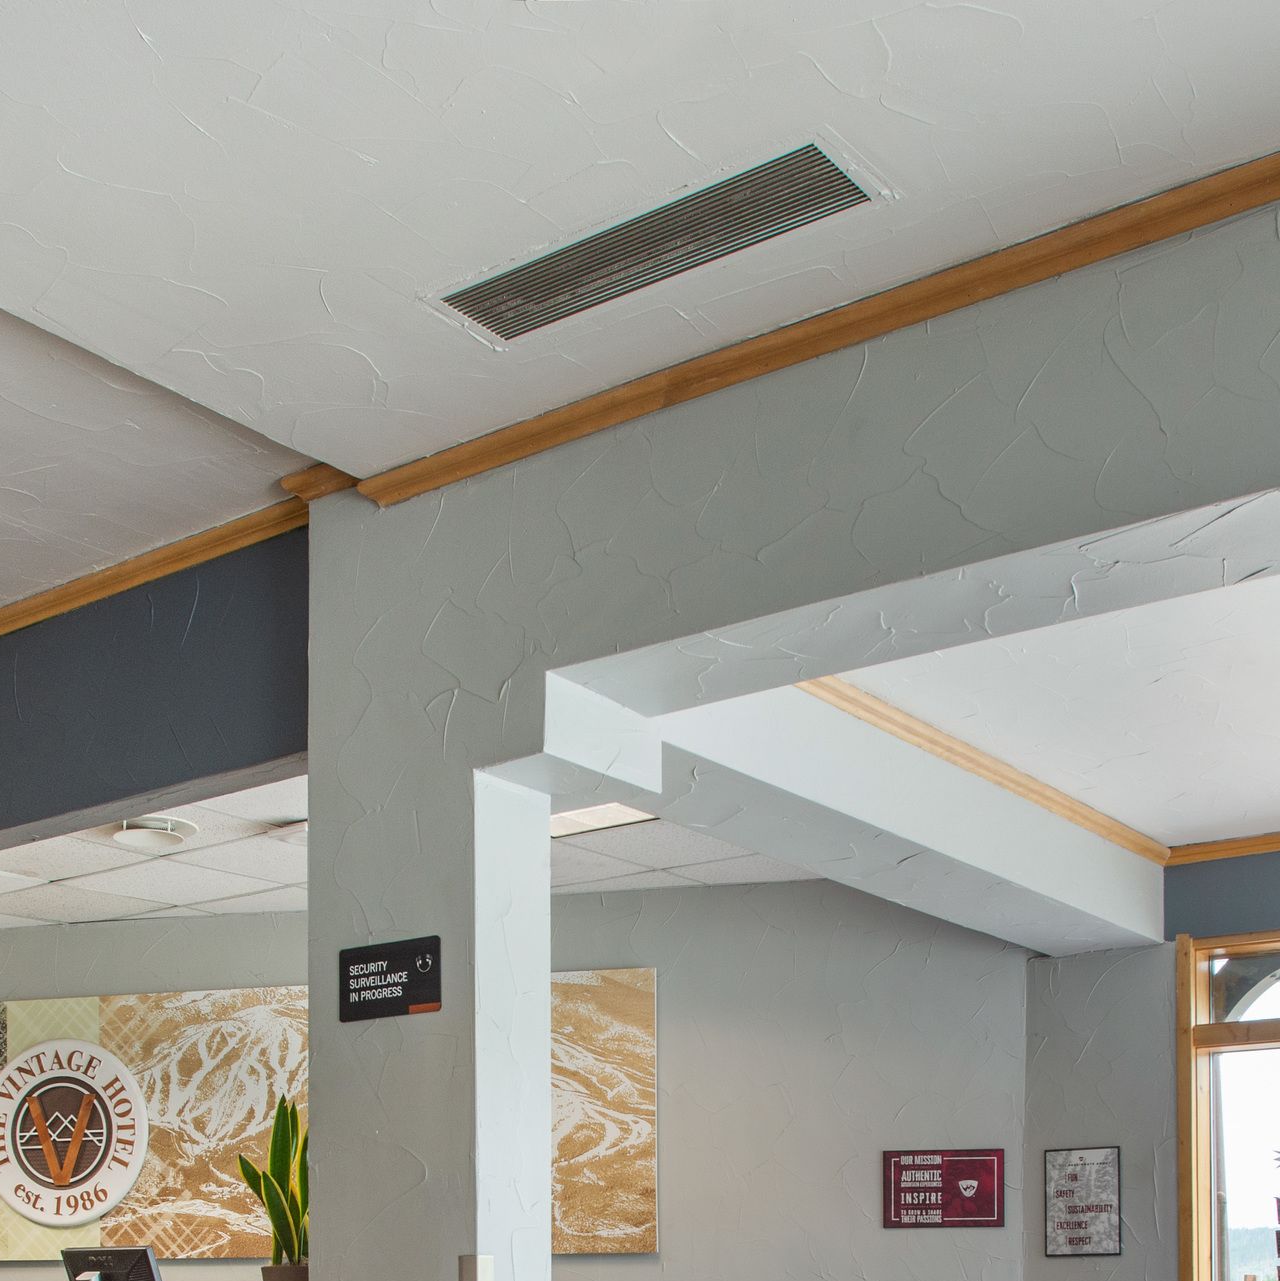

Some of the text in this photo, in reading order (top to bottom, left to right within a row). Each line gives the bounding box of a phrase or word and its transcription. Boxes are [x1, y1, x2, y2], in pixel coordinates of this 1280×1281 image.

[349, 961, 388, 976] SECURITY
[349, 972, 408, 989] SURVEILLANCE
[349, 986, 402, 1003] IN PROGRESS
[101, 1074, 137, 1171] HOTEL
[901, 1155, 942, 1165] OUR MISSION
[901, 1170, 942, 1182] AUTHENTIC
[14, 1181, 109, 1217] est. 1986
[901, 1192, 942, 1204] INSPIRE
[1055, 1190, 1075, 1198] SAFETY
[1068, 1236, 1092, 1246] RESPECT
